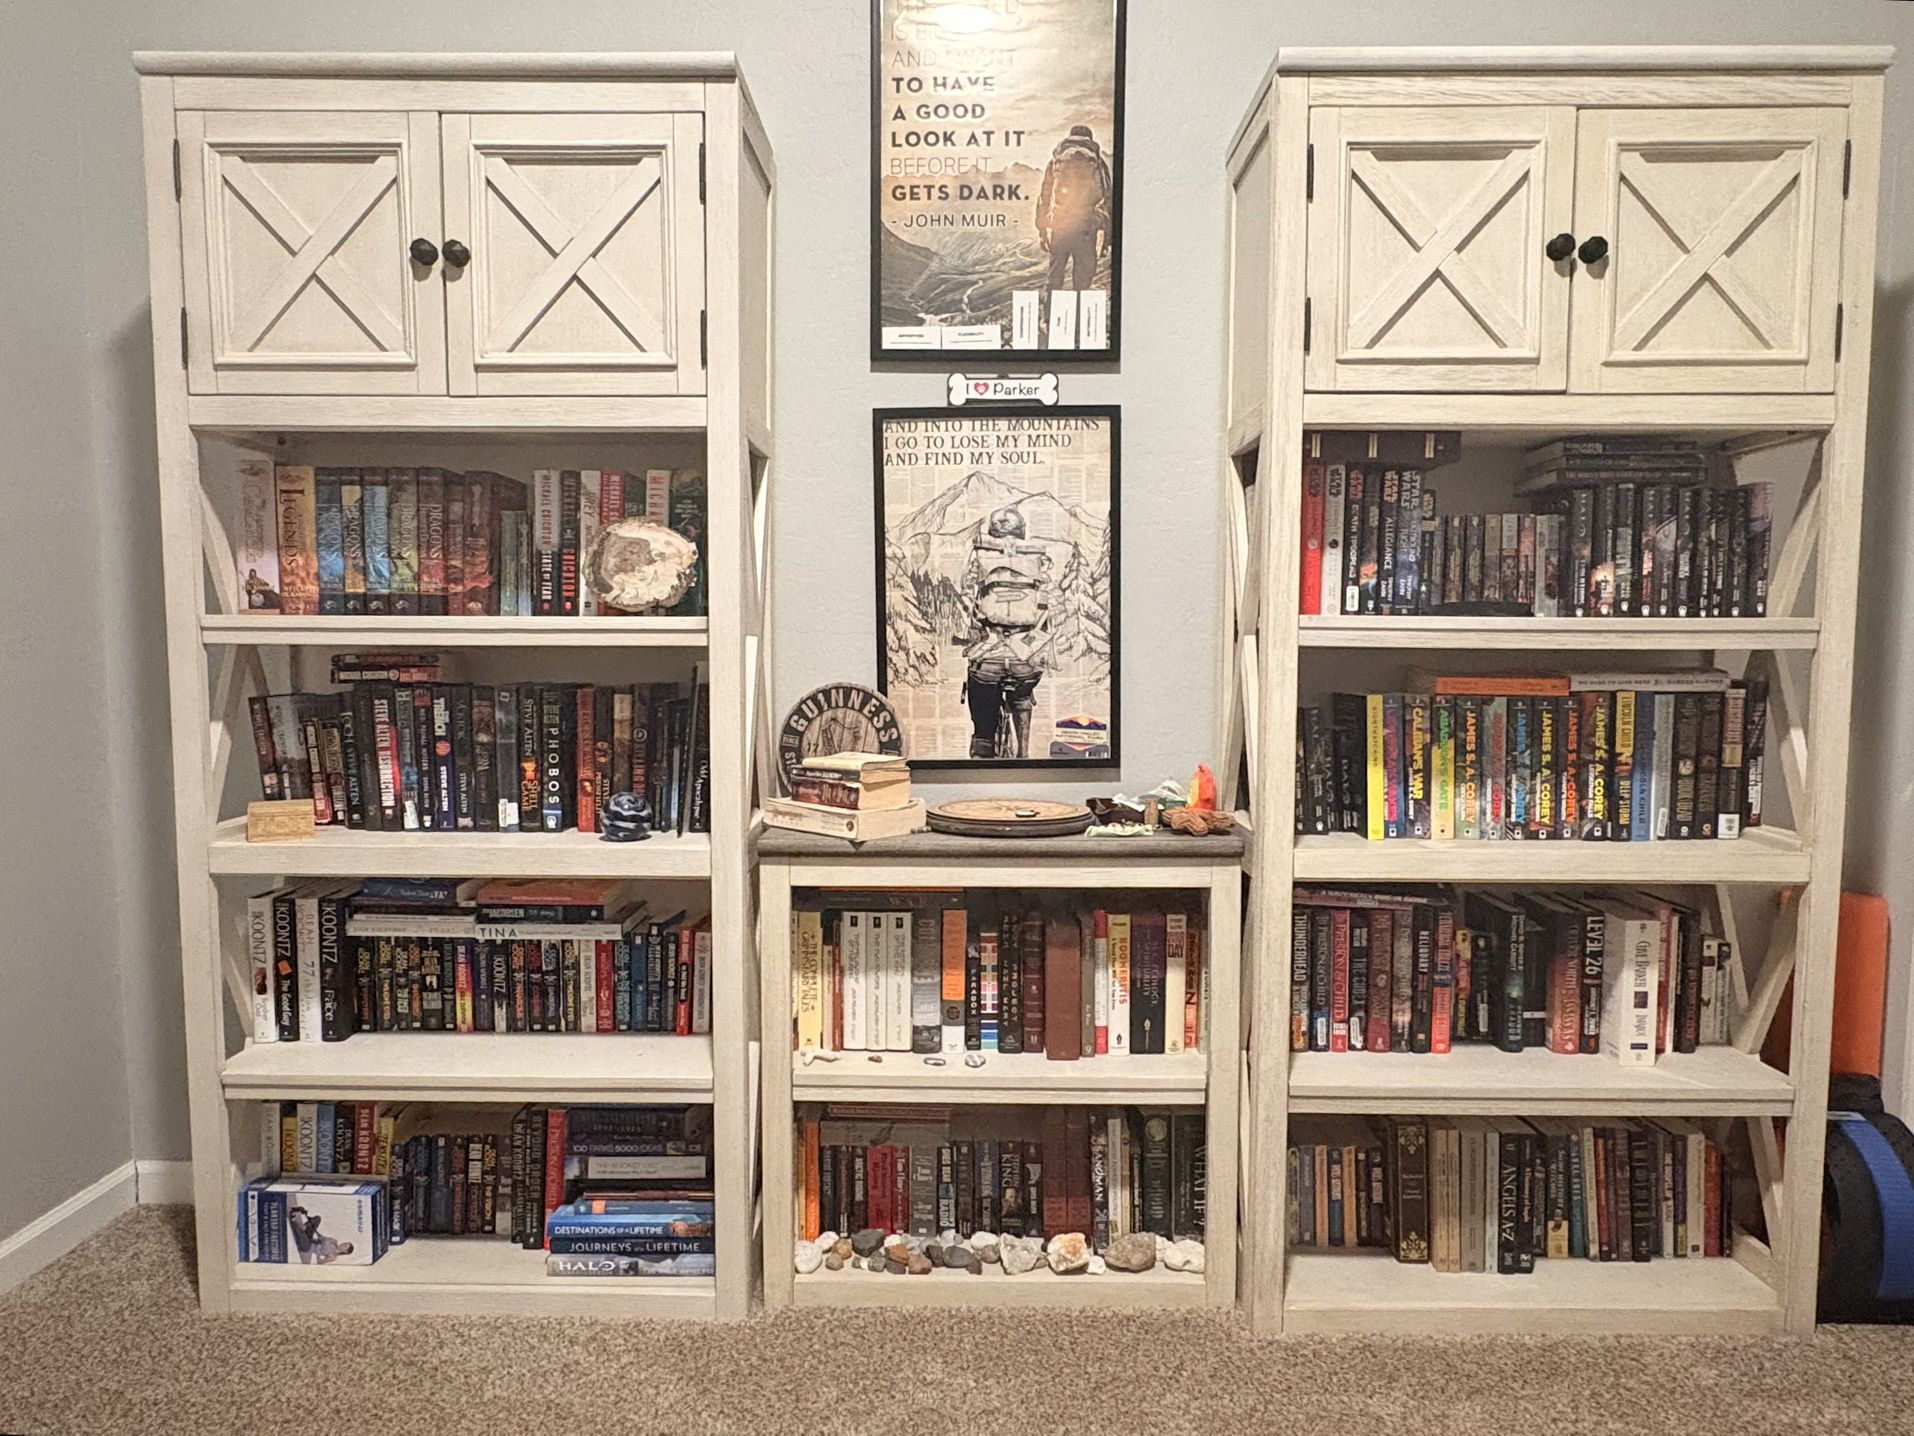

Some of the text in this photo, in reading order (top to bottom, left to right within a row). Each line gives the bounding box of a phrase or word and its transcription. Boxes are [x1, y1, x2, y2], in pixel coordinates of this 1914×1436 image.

[892, 76, 995, 94] TO HAVE
[892, 104, 985, 121] A GOOD
[891, 131, 1025, 148] LOOK AT IT
[890, 157, 992, 176] BEFORE IT
[891, 184, 1029, 201] GETS DARK.
[904, 214, 1006, 228] JOHN MUIR
[965, 382, 1040, 396] I Parker
[884, 419, 1099, 434] AND INTO THE MOUNTAINS
[884, 434, 1072, 450] I GO TO LOSE MY MIND
[884, 451, 1045, 466] AND FIND MY SOUL.
[1383, 471, 1392, 503] WARS
[1400, 470, 1411, 509] WARS
[1411, 470, 1421, 509] STAR
[279, 488, 305, 568] LEGENDS
[429, 503, 443, 560] DRAGONS
[1383, 516, 1394, 570] ALLEGIANCE
[541, 582, 552, 600] FEAR
[563, 548, 576, 598] CRICHTON
[433, 697, 446, 737] TRENCH
[524, 698, 534, 757] STEVE ALTEN
[789, 687, 899, 743] GUINNESS
[1541, 710, 1551, 752] JAMES
[1568, 710, 1578, 750] JAMES
[1595, 706, 1605, 747] JAMES
[1620, 696, 1632, 749] LINCOLN CHILD
[374, 699, 395, 807] STEVE ALTEN RESURRECTION
[548, 727, 560, 804] PHOBOS
[1411, 707, 1424, 800] CALIBAN'S WAR
[1465, 710, 1476, 823] JAMES S. A. COREY
[1516, 711, 1526, 825] JAMES COREY
[1542, 754, 1551, 765] S.
[1595, 763, 1604, 775] A.
[440, 765, 449, 812] STEVE ALTEN
[459, 772, 468, 813] STEVE ALTEN
[692, 777, 704, 819] Apocalypse
[1439, 779, 1449, 810] GATE
[1492, 783, 1502, 825] COREY
[1541, 783, 1551, 825] COREY
[1567, 781, 1576, 823] COREY
[1594, 778, 1604, 820] COREY
[1618, 780, 1631, 825] DEEP STORM
[251, 914, 266, 965] KOONTZ
[275, 906, 291, 957] KOONTZ
[305, 913, 315, 945] DEAN
[321, 906, 338, 963] KOONTZ
[479, 927, 518, 938] TINA
[1293, 914, 1308, 981] THUNDERHEAD
[302, 960, 315, 977] 77
[1118, 937, 1128, 1005] BOOMERITIS
[1317, 926, 1328, 1005] PRESTON CHILD
[1333, 923, 1346, 1020] PRESTON CHILD
[1418, 930, 1430, 973] RELIQUARY
[1585, 957, 1602, 975] 26
[494, 957, 506, 993] KOONTZ
[1352, 957, 1367, 1005] THE CODEX
[1634, 960, 1650, 988] BARKER
[281, 993, 291, 1011] Good
[281, 1011, 291, 1026] Guy
[300, 1119, 313, 1170] KOONTZ
[336, 1118, 345, 1160] KOONTZ
[358, 1108, 370, 1169] DEAN KOONTZ
[512, 1123, 523, 1181] DEAN KOONTZ
[530, 1163, 541, 1200] ORDER
[1002, 1154, 1013, 1187] KING
[1502, 1163, 1517, 1217] ANGELS
[554, 1225, 616, 1235] DESTINATIONS
[630, 1225, 664, 1235] LIFETIME
[940, 1198, 949, 1227] RADIO
[558, 1260, 616, 1271] HALO
[569, 1242, 700, 1252] JOURNEYS LIFETIME
